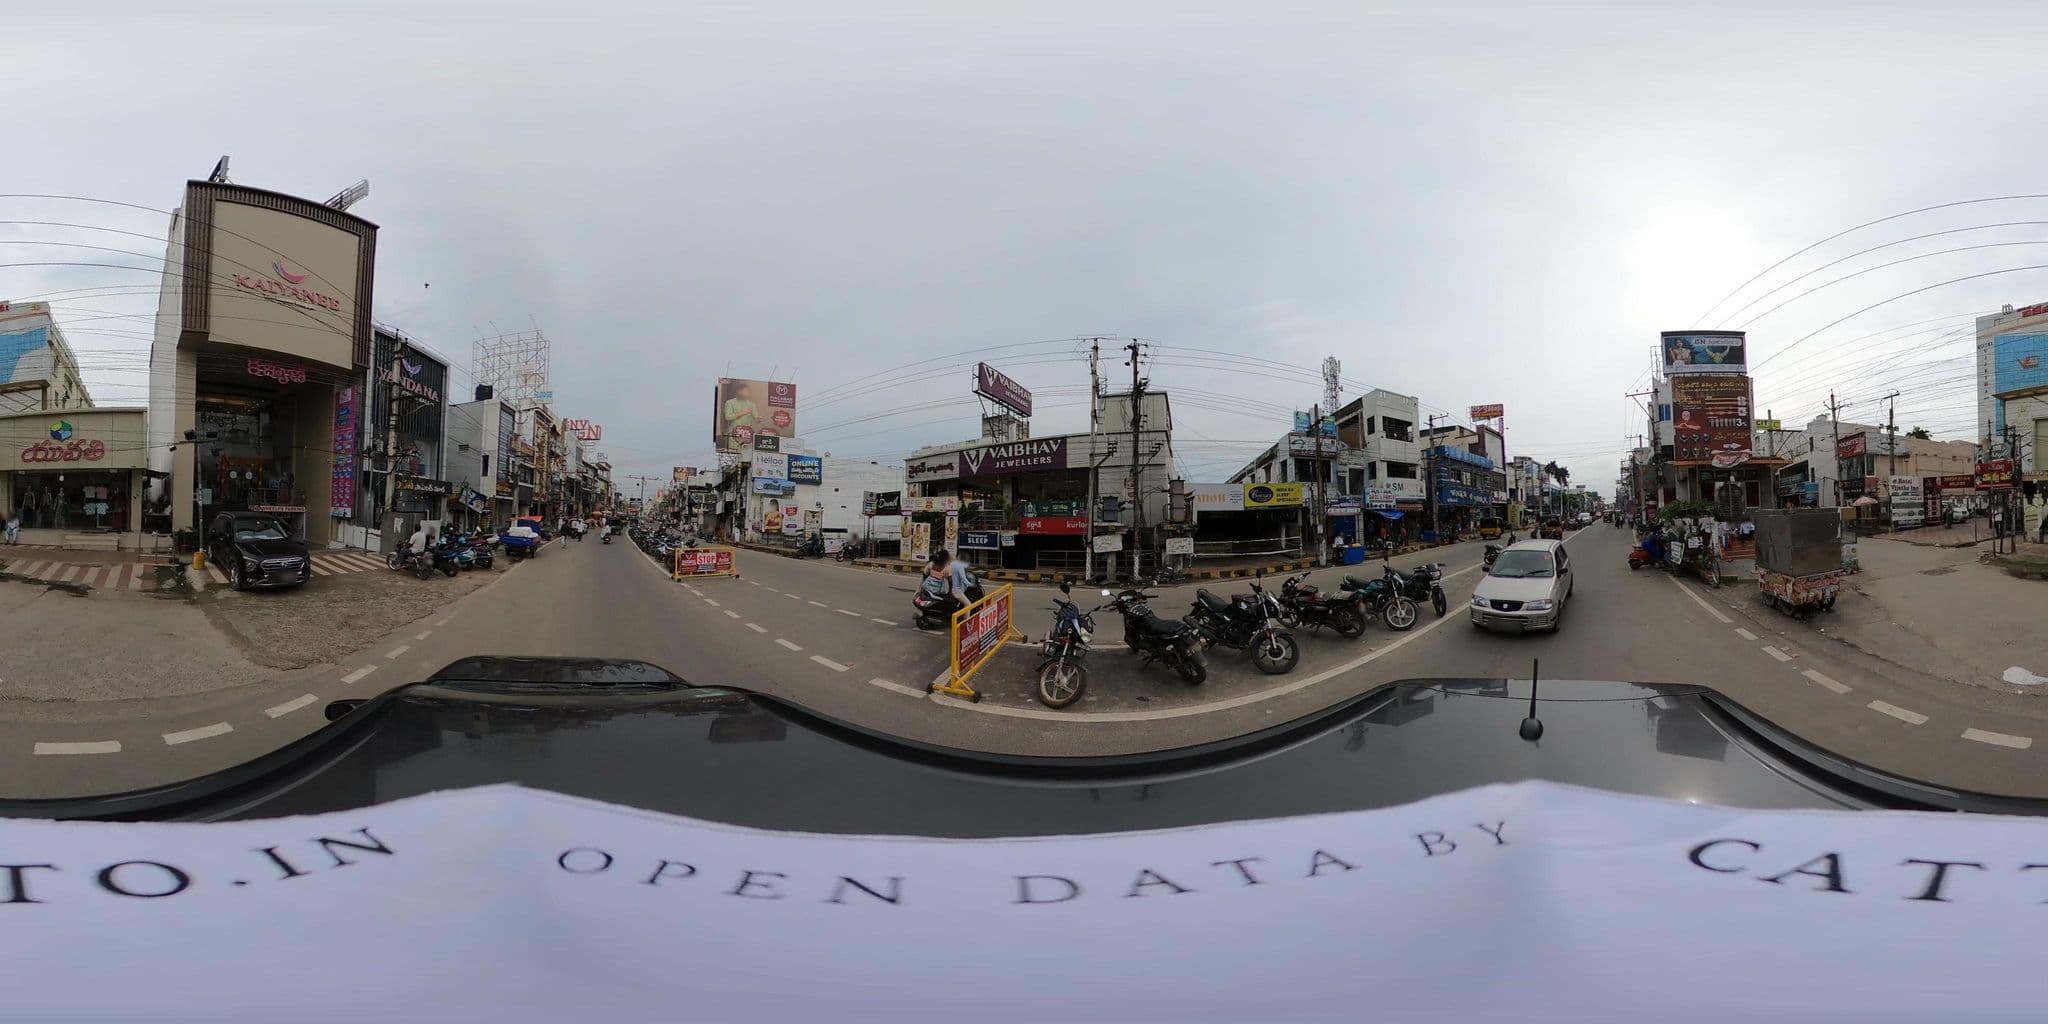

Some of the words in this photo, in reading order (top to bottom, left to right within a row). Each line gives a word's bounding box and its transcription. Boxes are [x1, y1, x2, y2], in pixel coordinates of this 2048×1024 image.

[232, 273, 341, 312] KALYANEE
[377, 366, 440, 402] VANDANA
[989, 440, 1061, 459] VAIBHAV
[995, 456, 1052, 468] JEWELLERS
[697, 555, 716, 564] STOP
[980, 610, 998, 636] STOP
[556, 847, 903, 905] OPEN
[1012, 848, 1359, 904] DATA
[1415, 820, 1510, 857] BY
